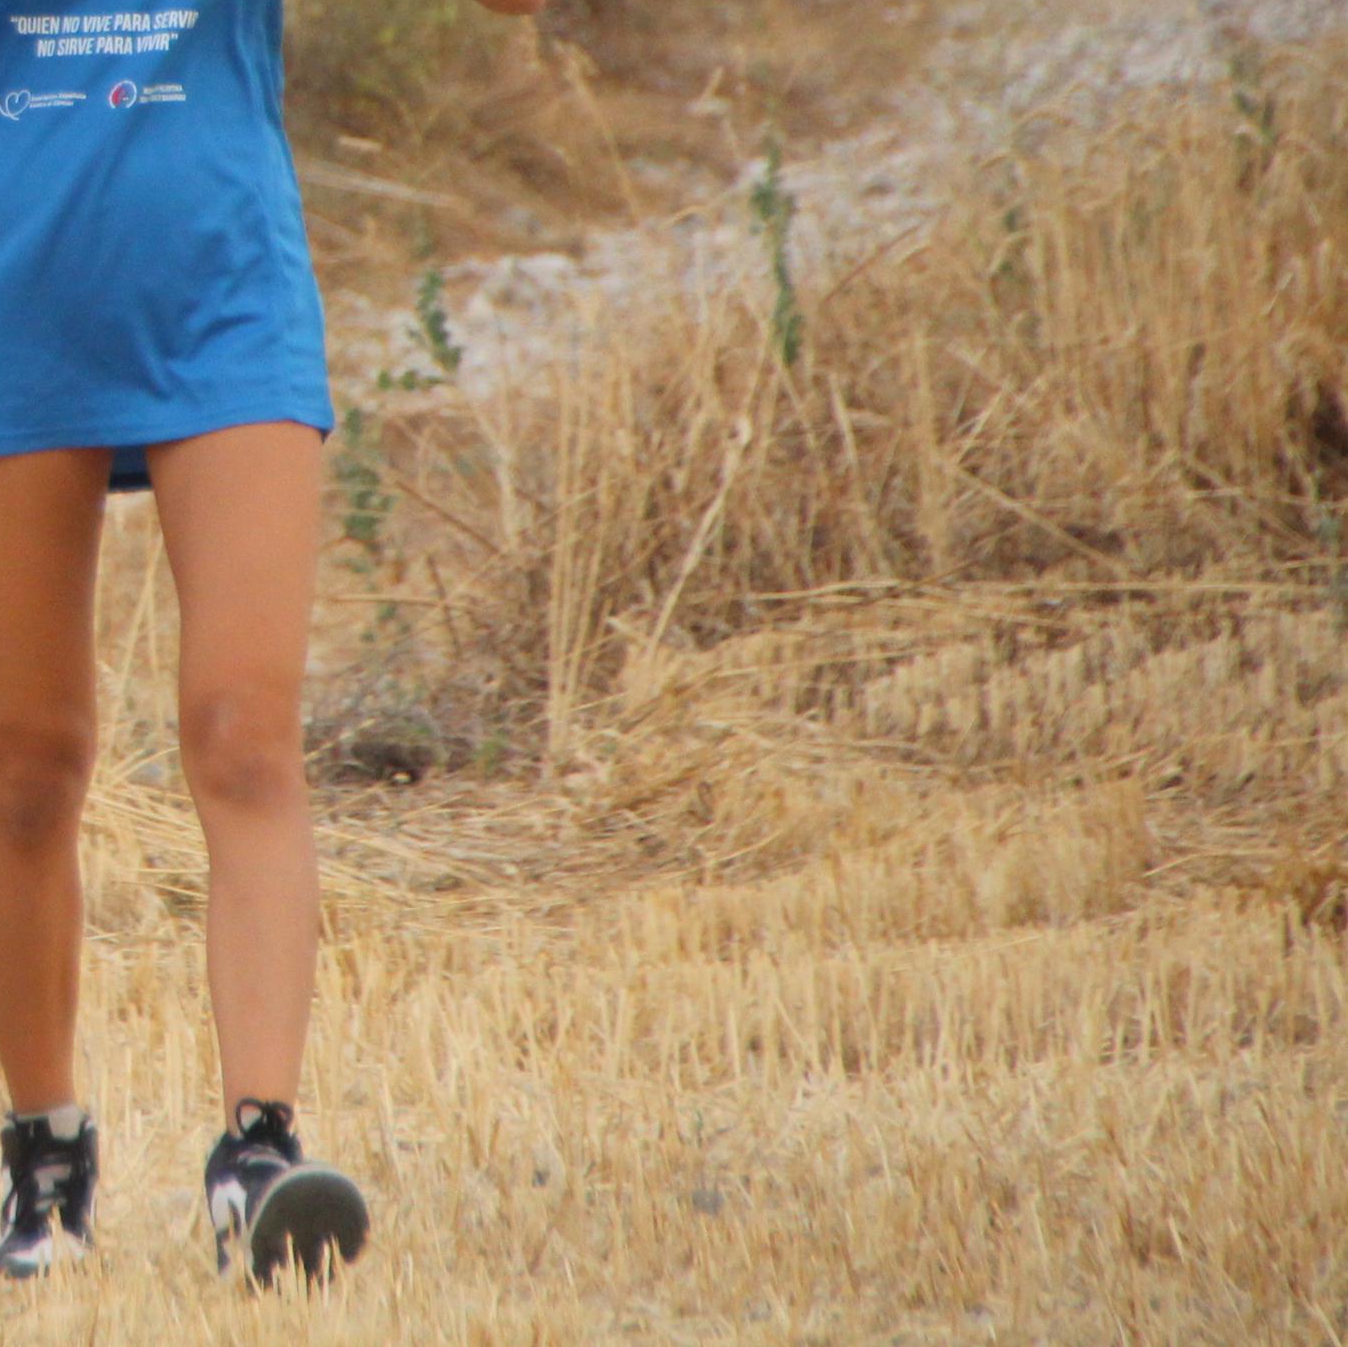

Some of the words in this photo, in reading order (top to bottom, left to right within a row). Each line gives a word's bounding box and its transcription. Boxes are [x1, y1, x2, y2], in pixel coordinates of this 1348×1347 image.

[62, 16, 81, 34] NO
[83, 15, 112, 33] VIVE
[114, 13, 151, 32] PARA
[37, 38, 56, 57] NO
[57, 36, 94, 56] SIRVE
[95, 35, 133, 55] PARA
